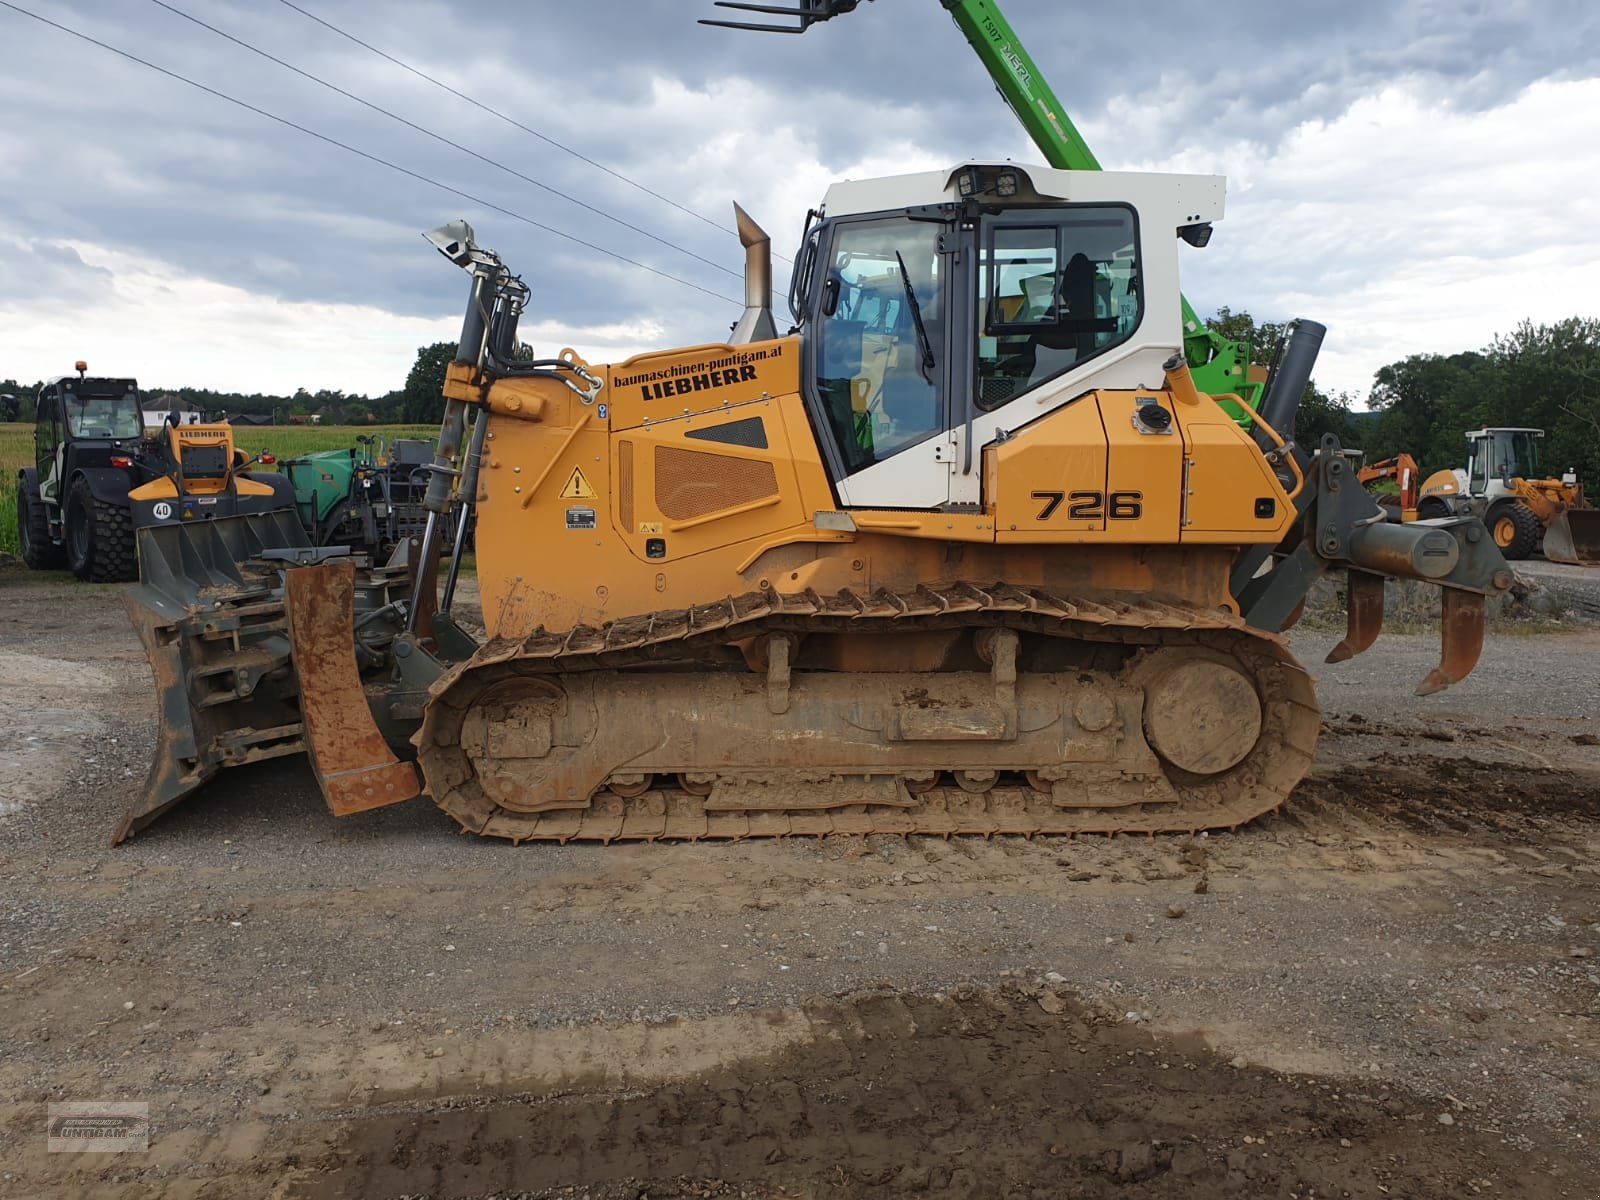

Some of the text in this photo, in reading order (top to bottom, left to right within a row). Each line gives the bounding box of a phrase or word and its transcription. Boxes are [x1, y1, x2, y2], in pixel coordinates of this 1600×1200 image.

[982, 15, 1003, 42] TS07
[614, 345, 782, 388] baumaschinen-puntigam.at
[641, 365, 758, 401] LIEBHERR
[180, 430, 226, 438] LIEBHERR
[155, 505, 168, 516] 40
[1031, 490, 1143, 520] 726
